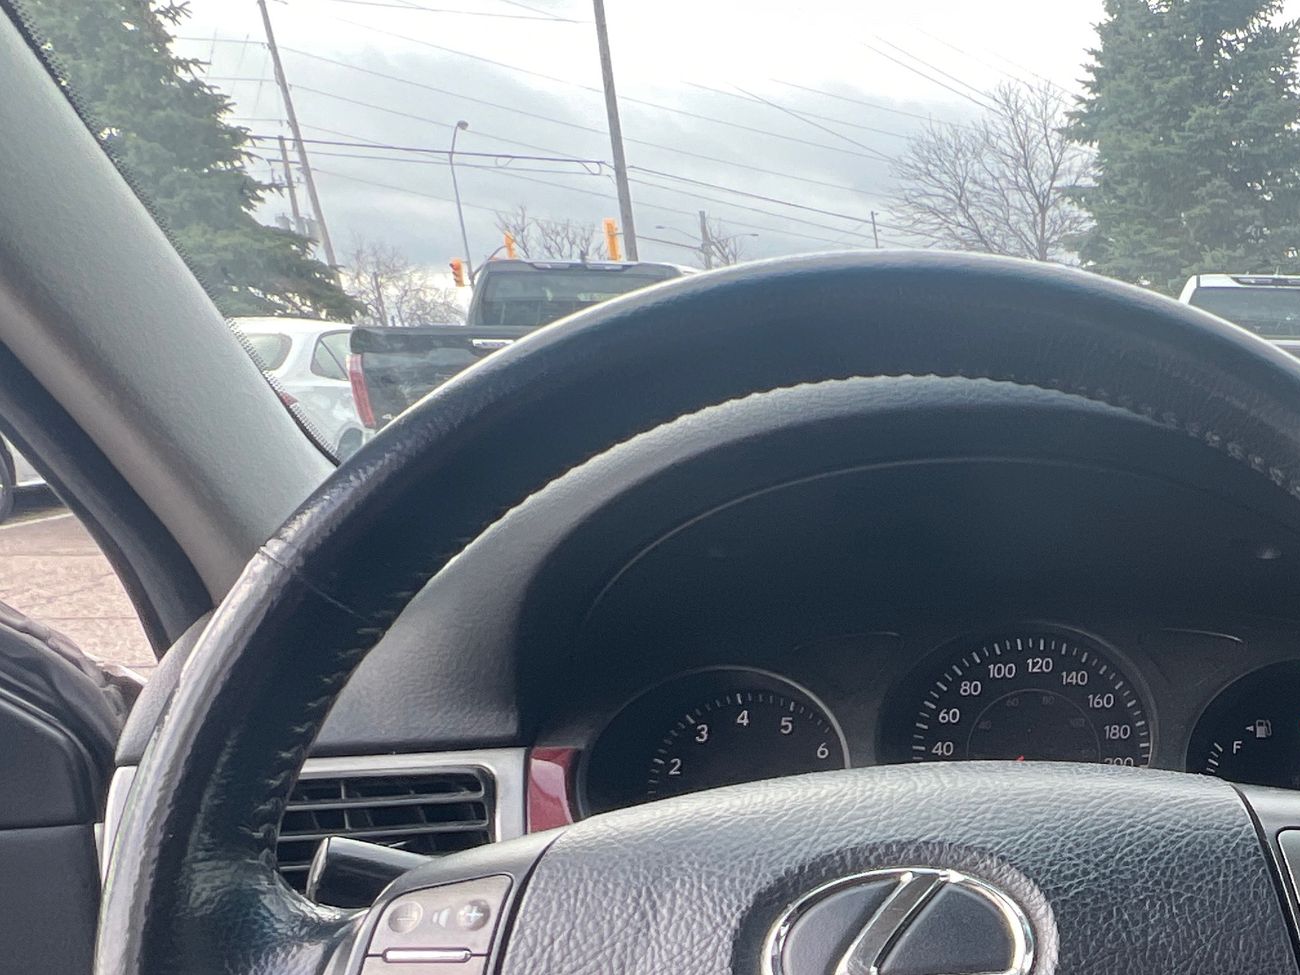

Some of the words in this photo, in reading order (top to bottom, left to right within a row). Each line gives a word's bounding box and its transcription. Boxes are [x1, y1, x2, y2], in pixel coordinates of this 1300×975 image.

[988, 663, 1016, 679] 100
[1027, 657, 1053, 673] 120
[1061, 671, 1088, 686] 140
[960, 681, 981, 696] 80
[1087, 694, 1115, 708] 160
[736, 710, 750, 726] 4
[938, 709, 960, 724] 60
[696, 724, 708, 742] 3
[780, 717, 793, 734] 5
[1104, 724, 1131, 740] 180
[817, 742, 829, 758] 6
[931, 742, 954, 756] 40
[1232, 740, 1242, 753] F
[669, 758, 681, 775] 2
